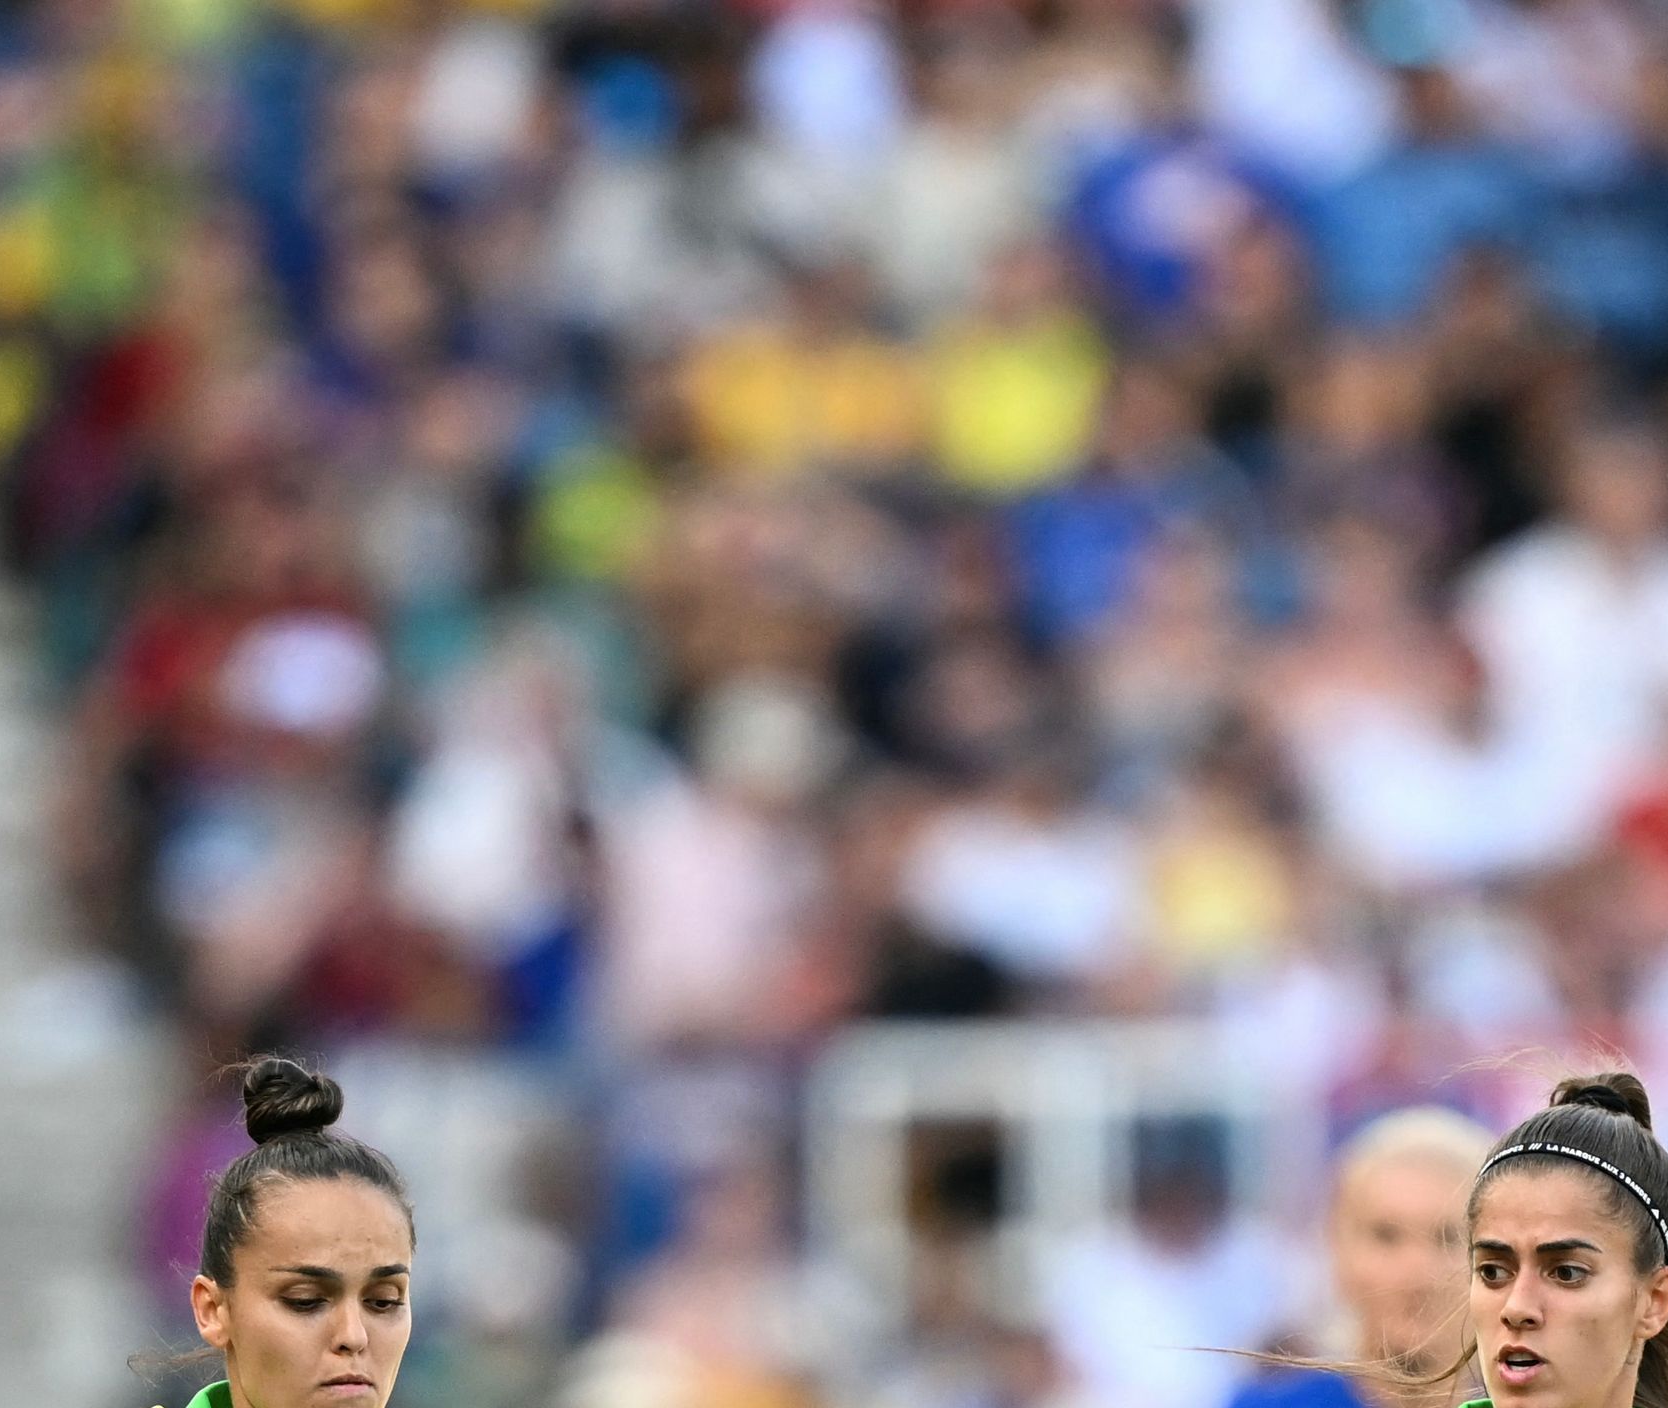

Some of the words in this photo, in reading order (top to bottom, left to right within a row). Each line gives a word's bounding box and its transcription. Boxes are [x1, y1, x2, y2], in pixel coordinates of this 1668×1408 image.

[1545, 1143, 1559, 1152] LA
[1561, 1146, 1601, 1165] MARQUE
[1601, 1161, 1620, 1176] AUX
[1625, 1176, 1652, 1205] BANDES
